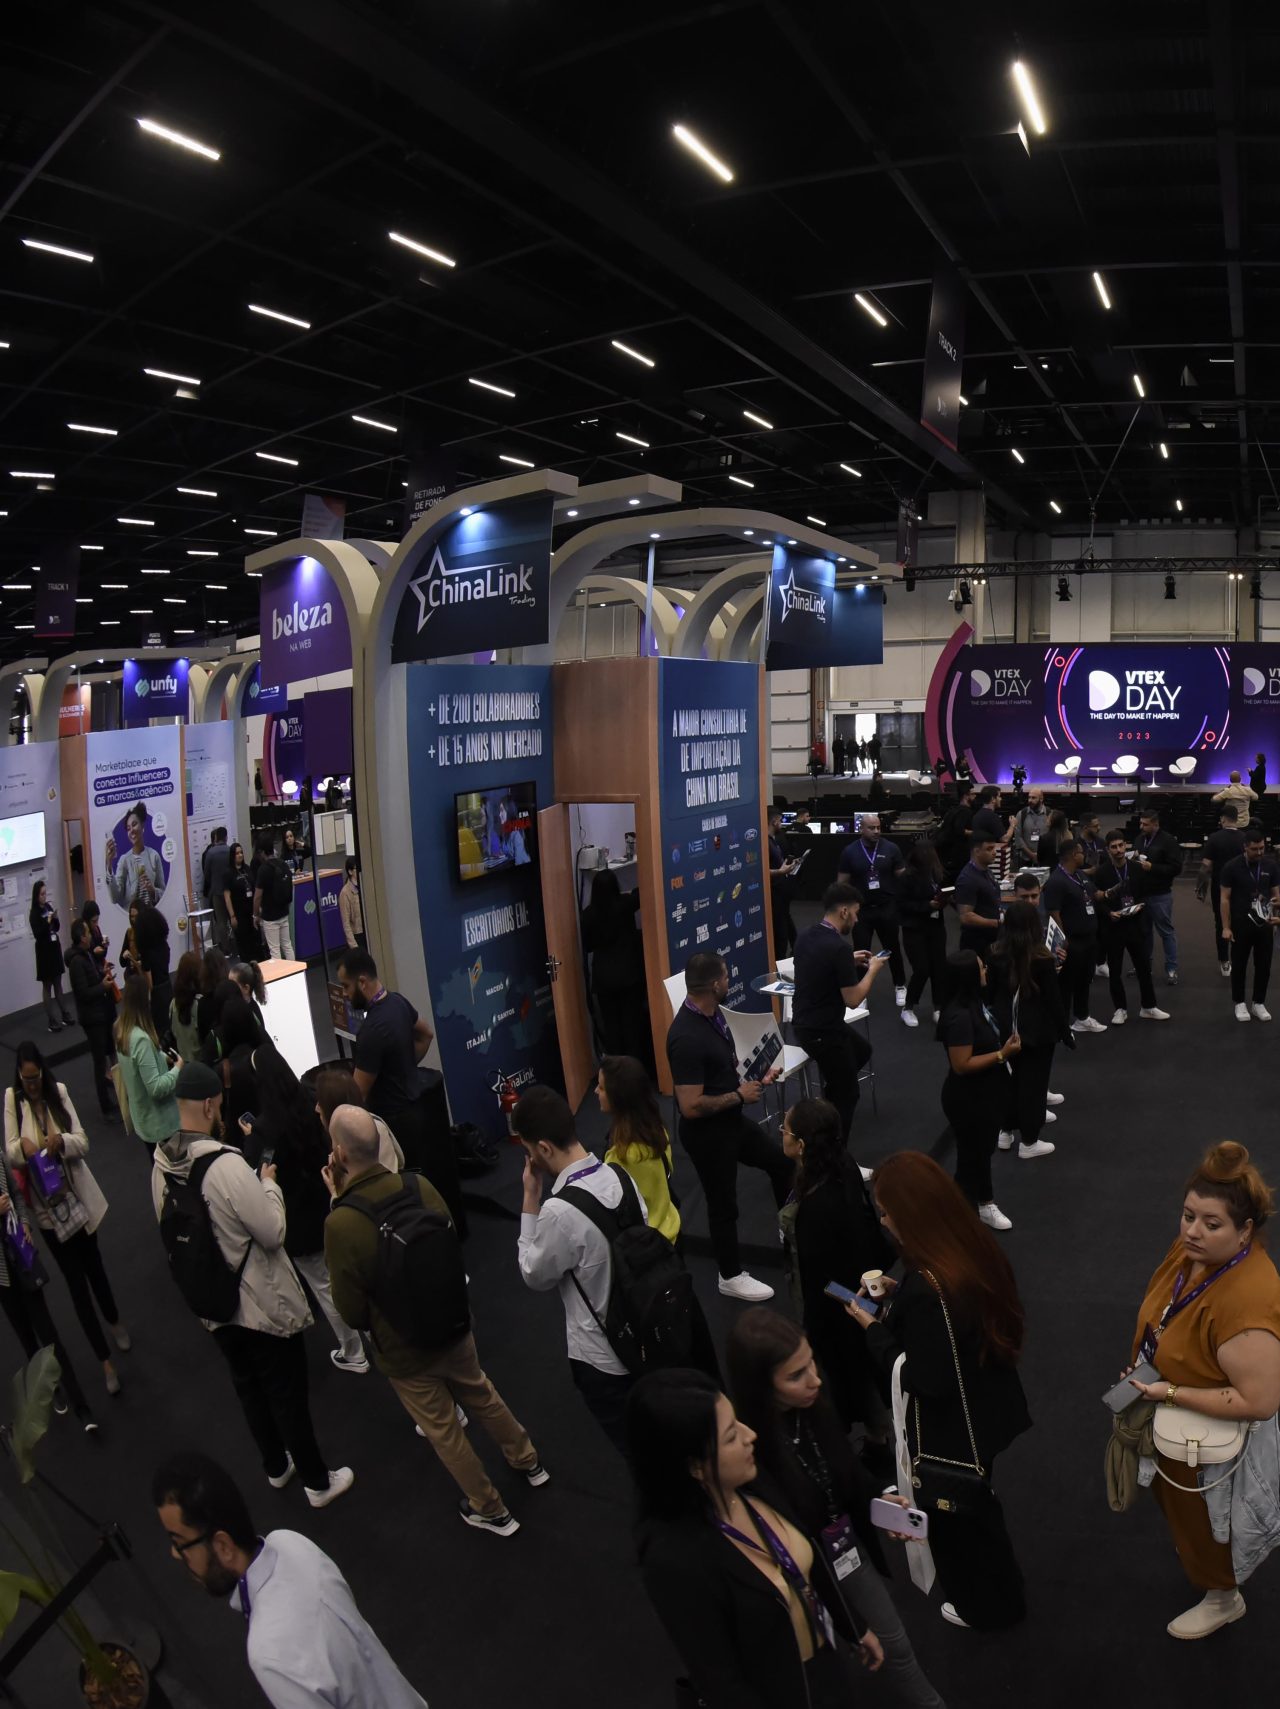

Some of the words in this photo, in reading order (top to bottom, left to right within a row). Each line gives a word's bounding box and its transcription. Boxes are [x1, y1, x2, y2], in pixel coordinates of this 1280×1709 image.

[414, 486, 446, 500] RETIRADA
[415, 501, 424, 510] DE
[429, 563, 534, 608] ChinaLink
[787, 590, 826, 614] ChinaLink
[272, 600, 332, 640] beleza
[289, 643, 298, 653] NA
[299, 638, 312, 650] WEB
[994, 669, 1020, 679] VTEX
[1125, 670, 1165, 685] VTEX
[151, 675, 178, 694] unfy
[994, 679, 1032, 697] DAY
[1126, 685, 1182, 711] DAY
[438, 693, 451, 725] DE
[453, 693, 471, 724] 200
[473, 691, 540, 723] COLABORADORES
[1090, 712, 1104, 720] THE
[1104, 712, 1116, 720] DAY
[1116, 712, 1126, 720] TO
[1126, 712, 1145, 720] MAKE
[1146, 712, 1152, 720] IT
[1152, 712, 1180, 720] HAPPEN
[288, 725, 303, 738] DAY
[672, 709, 678, 738] A
[679, 709, 700, 737] MAIOR
[700, 708, 739, 736] CONSULTORIA
[1118, 732, 1150, 740] 2023
[438, 735, 451, 767] DE
[453, 734, 463, 764] 15
[465, 731, 489, 763] ANOS
[491, 730, 503, 760] NO
[505, 729, 542, 759] MERCADO
[680, 742, 690, 773] DE
[691, 735, 732, 772] IMPORTAÇÃO
[732, 738, 741, 766] DA
[95, 759, 142, 773] Marketplace
[143, 757, 157, 767] que
[96, 776, 127, 789] conecta
[686, 775, 707, 808] CHINA
[707, 774, 718, 804] NO
[718, 771, 740, 802] BRASIL
[97, 796, 106, 805] as
[688, 838, 708, 853] NET
[464, 904, 514, 947] ESCRITÓRIOS
[515, 901, 530, 929] EM:
[497, 1008, 515, 1021] SANTOS
[466, 1031, 487, 1051] ITAJAÍ
